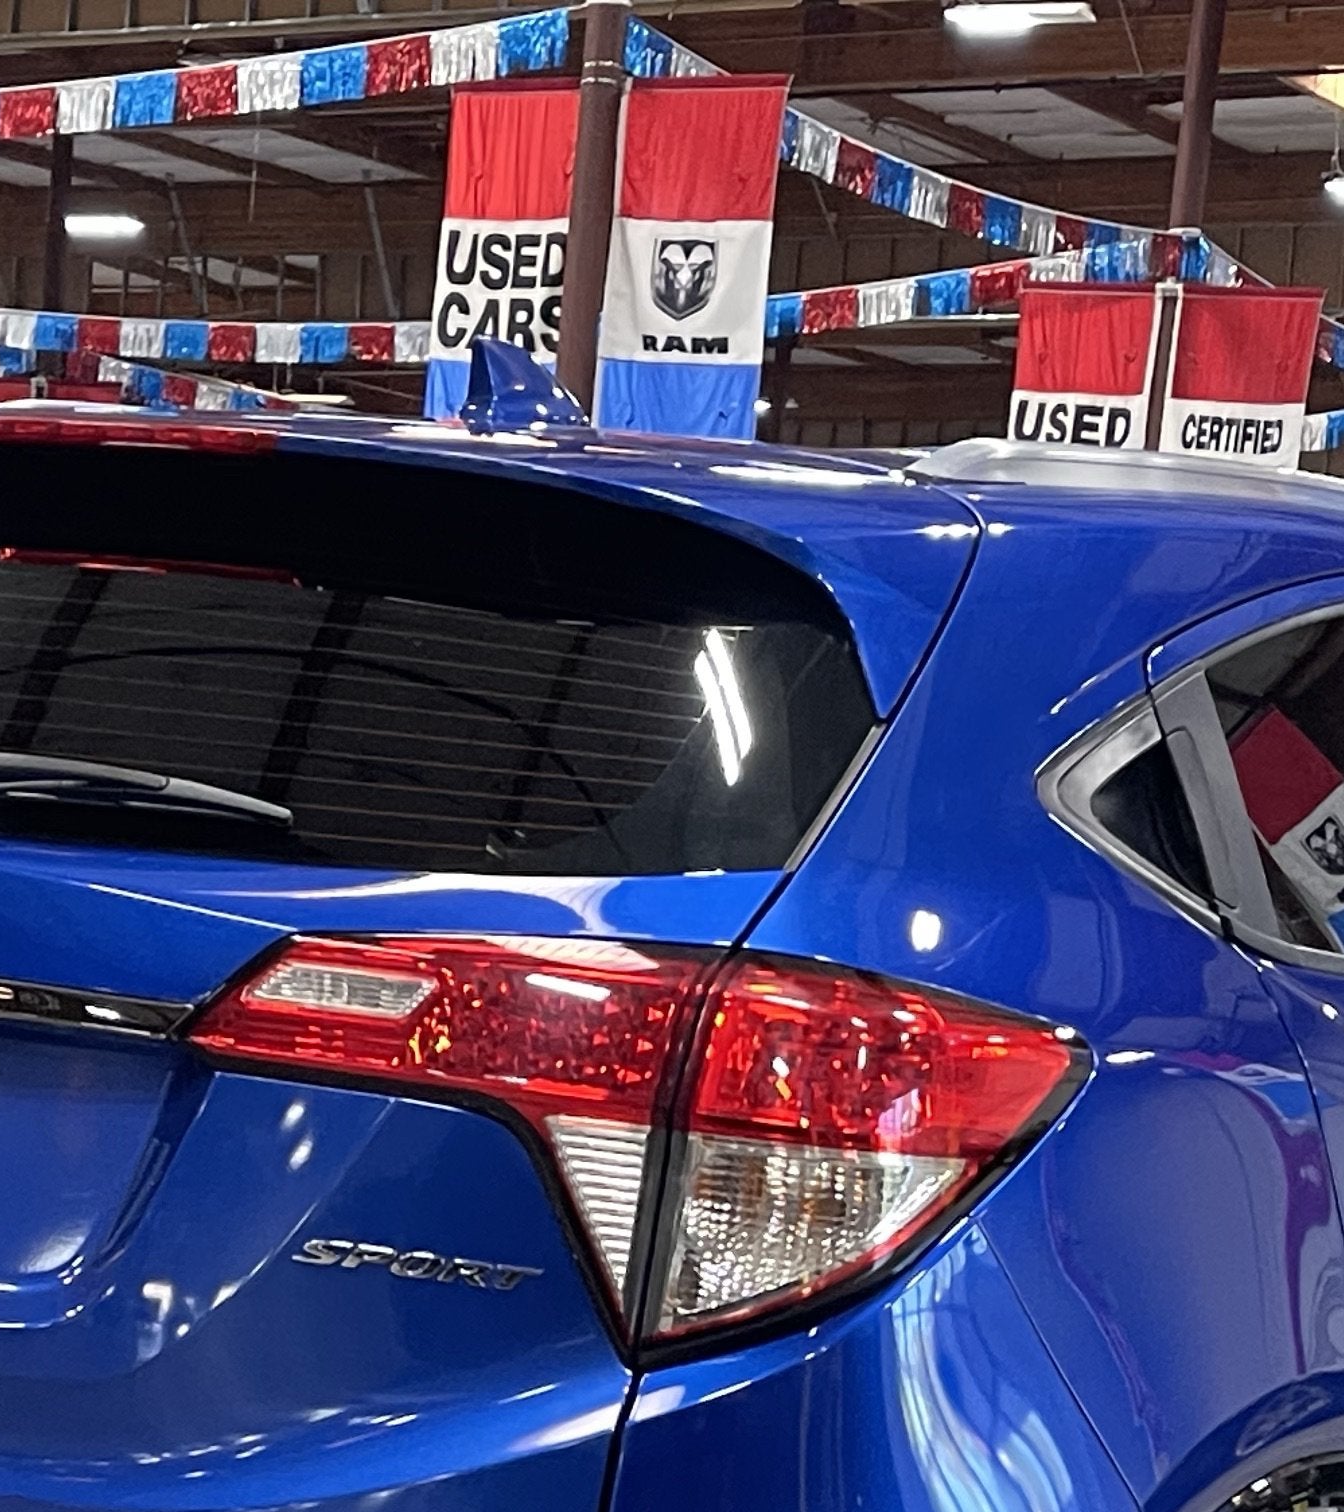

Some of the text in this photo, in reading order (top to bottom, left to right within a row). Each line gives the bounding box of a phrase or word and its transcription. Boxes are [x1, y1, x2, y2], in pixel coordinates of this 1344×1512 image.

[445, 230, 568, 290] USED
[437, 291, 563, 354] CARS
[642, 334, 729, 355] RAM
[1014, 400, 1132, 448] USED
[1181, 413, 1283, 455] CERTIFIED
[292, 1239, 545, 1291] SPORT
